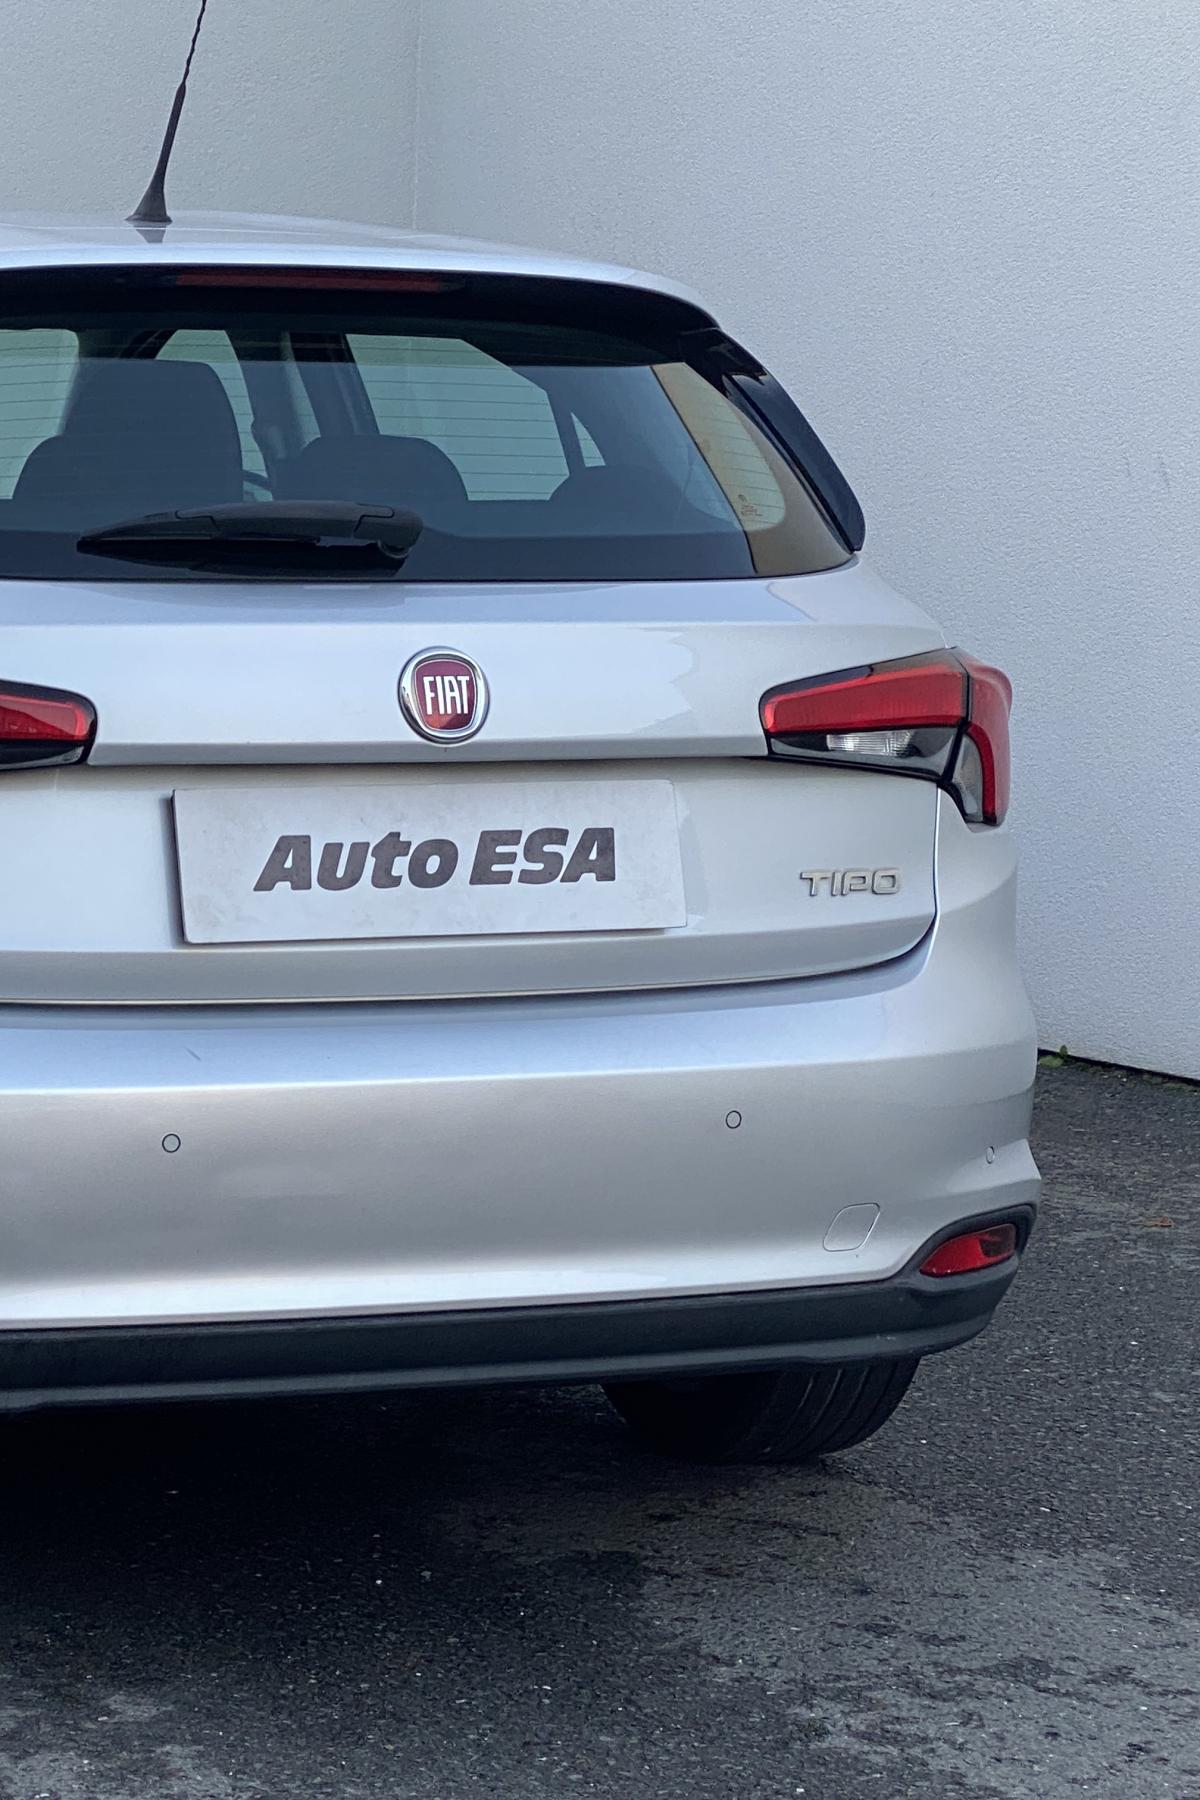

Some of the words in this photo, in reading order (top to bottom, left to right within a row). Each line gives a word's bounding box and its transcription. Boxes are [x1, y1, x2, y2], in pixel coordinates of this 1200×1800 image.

[423, 675, 470, 715] FIAT
[252, 831, 459, 892] Auto
[469, 827, 616, 886] ESA
[799, 869, 901, 897] TIPO
